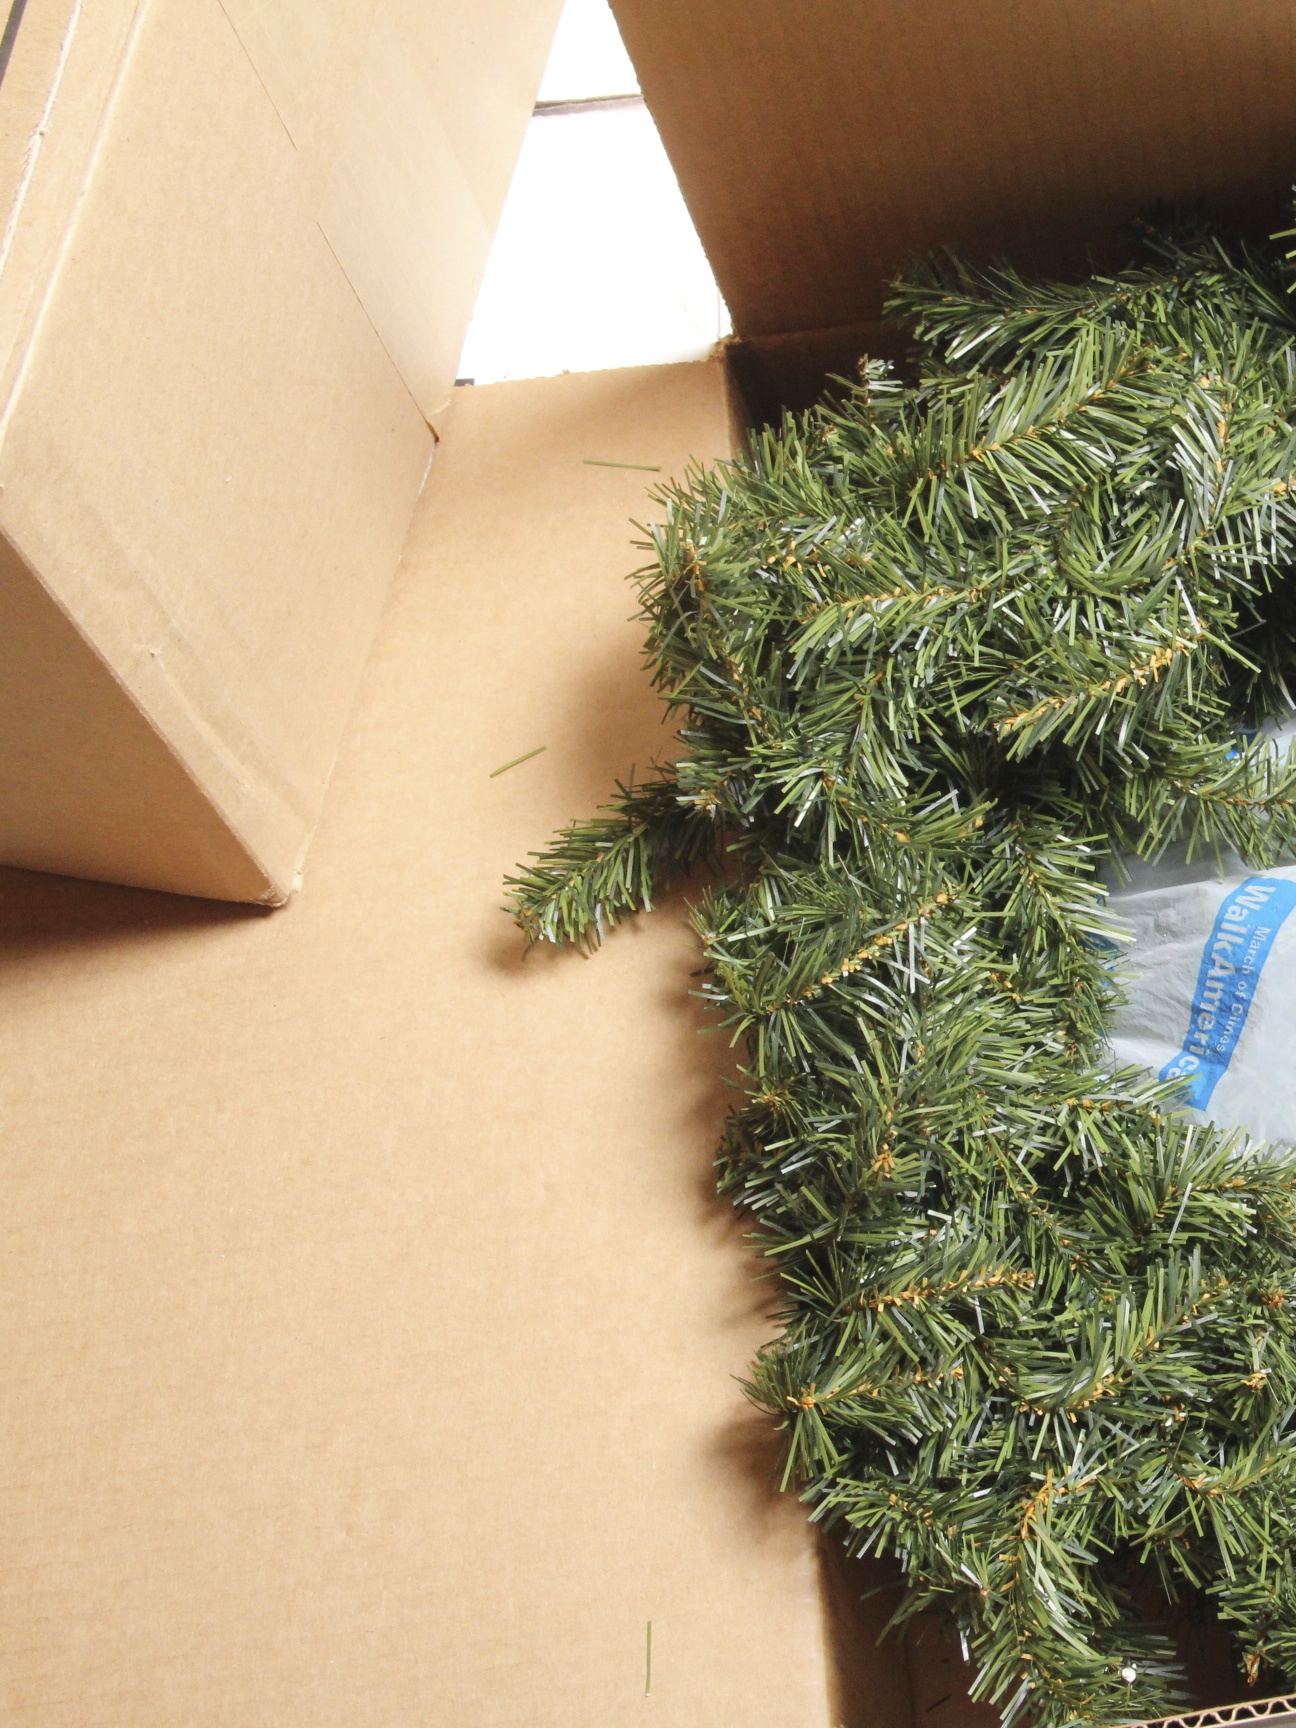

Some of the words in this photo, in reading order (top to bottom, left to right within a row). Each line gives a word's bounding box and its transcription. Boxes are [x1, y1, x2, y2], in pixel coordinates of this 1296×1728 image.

[1240, 925, 1271, 975] March
[1235, 980, 1249, 998] of
[1216, 1002, 1244, 1052] Dimes
